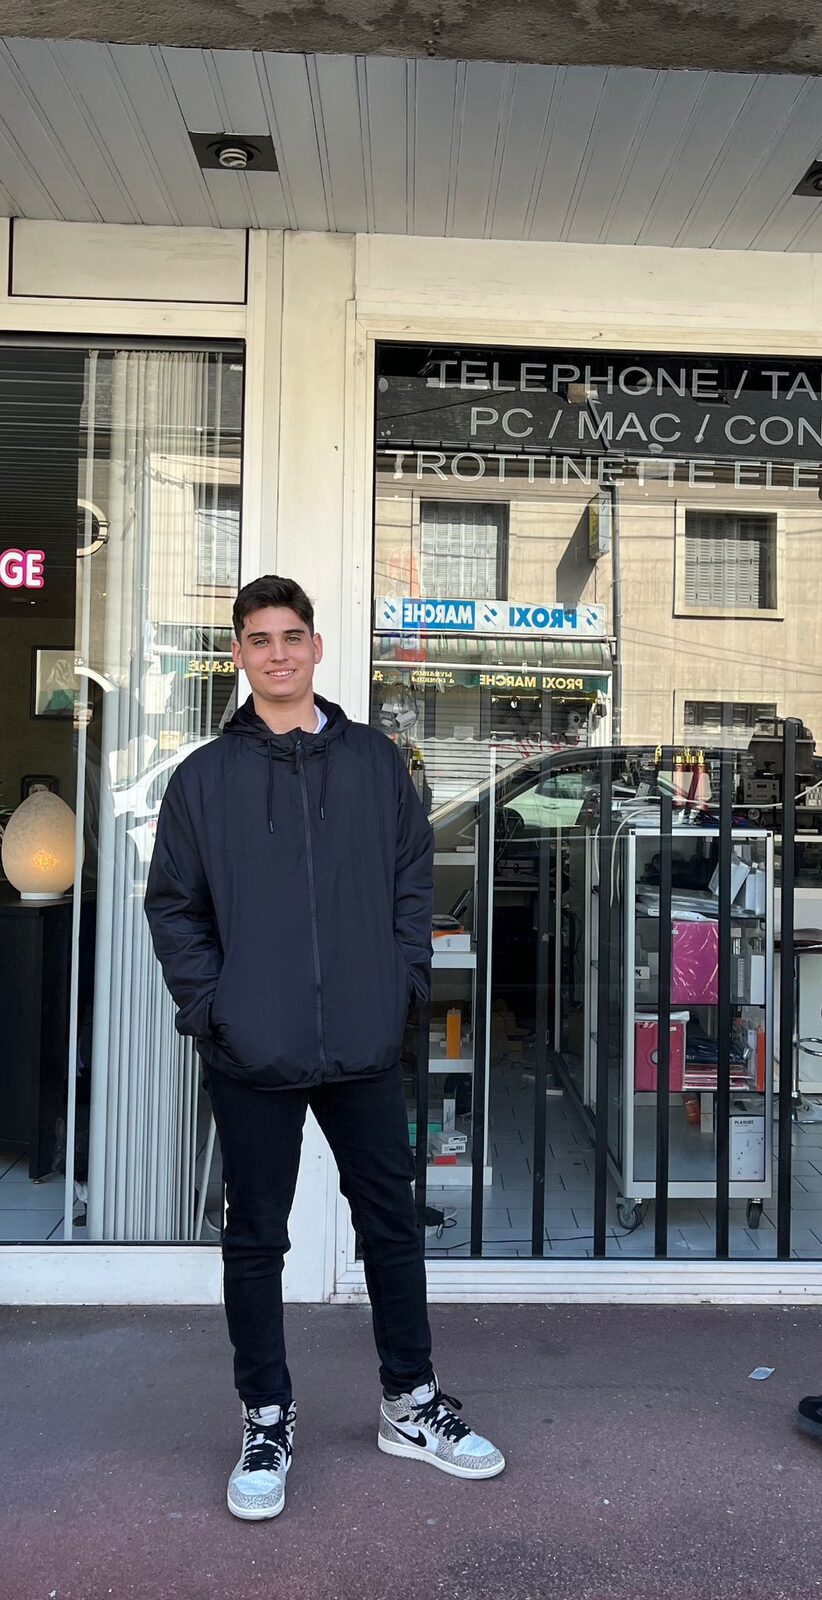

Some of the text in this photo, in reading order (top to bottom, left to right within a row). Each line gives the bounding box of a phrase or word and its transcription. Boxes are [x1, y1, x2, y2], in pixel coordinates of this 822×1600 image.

[431, 360, 822, 401] TELEPHONE / TA
[470, 407, 534, 438] PC
[548, 410, 563, 439] /
[578, 411, 682, 442] MAC
[725, 415, 822, 446] CON
[386, 450, 820, 491] TROTTINETTE ELE
[0, 549, 45, 588] GE
